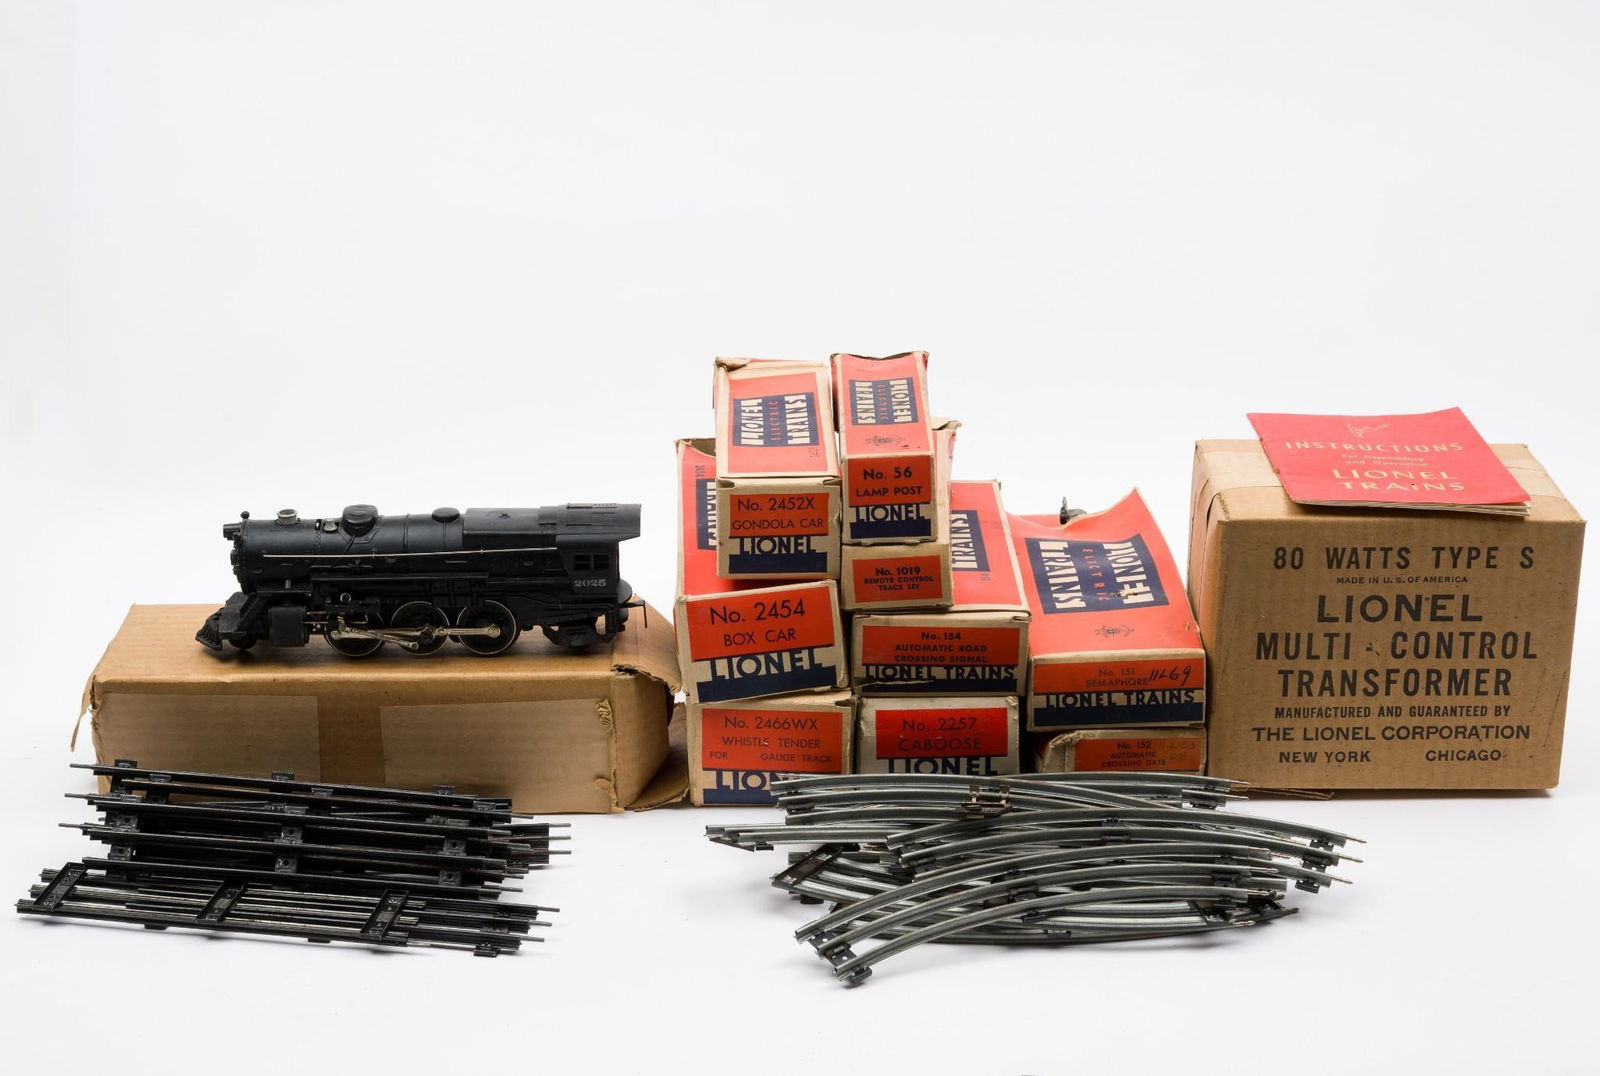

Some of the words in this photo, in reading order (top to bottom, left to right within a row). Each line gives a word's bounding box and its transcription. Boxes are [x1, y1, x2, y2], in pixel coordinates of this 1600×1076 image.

[855, 382, 876, 424] TRAINS
[890, 379, 912, 422] LIONEL
[741, 398, 764, 445] LIONEL
[784, 394, 810, 445] TRAINS
[1285, 441, 1464, 453] INSTRUCTIONS
[863, 468, 888, 480] No.
[894, 466, 913, 479] 56
[1332, 468, 1457, 480] LIONEL
[856, 486, 889, 498] LAMP
[894, 486, 922, 496] POST
[1338, 481, 1466, 492] TRAINS
[737, 498, 763, 512] No.
[768, 496, 816, 510] 2452X
[855, 504, 926, 522] LIONEL
[732, 520, 795, 532] GONDOLA
[800, 518, 824, 530] CAR
[739, 536, 816, 555] LIONEL
[1274, 546, 1304, 570] 80
[1325, 546, 1411, 570] WATTS
[1432, 546, 1500, 569] TYPE
[1520, 546, 1535, 570] S
[875, 568, 893, 576] No.
[896, 566, 920, 576] 1019
[1039, 541, 1087, 609] TRAINS
[1103, 541, 1155, 605] LIONEL
[574, 578, 608, 588] 2025
[1336, 576, 1365, 584] MADE
[1368, 576, 1379, 584] IN
[1408, 576, 1420, 584] OF
[1423, 576, 1468, 584] AMERICA
[710, 605, 745, 625] No.
[754, 600, 806, 621] 2454
[1317, 594, 1483, 623] LIONEL
[723, 631, 756, 647] BOX
[764, 628, 797, 642] CAR
[921, 632, 940, 640] No.
[944, 632, 962, 640] 154
[895, 644, 954, 652] AUTOMATIC
[958, 644, 988, 652] ROAD
[1256, 632, 1352, 660] MULTI
[1390, 631, 1538, 660] CONTROL
[709, 647, 823, 682] LIONEL
[894, 654, 945, 662] CROSSING
[864, 666, 936, 680] LIONEL
[944, 666, 1015, 680] TRAINS
[1098, 668, 1117, 676] No.
[1121, 668, 1135, 676] 151
[1086, 679, 1149, 688] SEMAPHORE
[1277, 668, 1512, 698] TRANSFORMER
[1046, 692, 1118, 708] LIONEL
[1124, 690, 1194, 705] TRAINS
[1274, 706, 1371, 719] MANUFACTURED
[1377, 706, 1402, 718] AND
[1408, 705, 1488, 718] GUARANTEED
[1494, 704, 1512, 716] BY
[724, 716, 748, 728] No.
[754, 716, 819, 731] 2466WX
[902, 719, 929, 732] No.
[938, 718, 977, 731] 2257
[1252, 726, 1295, 742] THE
[1302, 726, 1376, 742] LIONEL
[1382, 724, 1531, 741] CORPORATION
[722, 736, 770, 747] WHISTLE
[777, 738, 821, 748] TENDER
[898, 738, 982, 752] CABOOSE
[1136, 741, 1152, 749] 152
[710, 751, 728, 760] FOR
[760, 753, 796, 762] GAUGE
[802, 754, 832, 762] TRACK
[1279, 751, 1318, 763] NEW
[1324, 750, 1372, 763] YORK
[1425, 750, 1502, 762] CHICAGO
[888, 757, 998, 776] LIONEL
[1102, 760, 1142, 768] CROSSING
